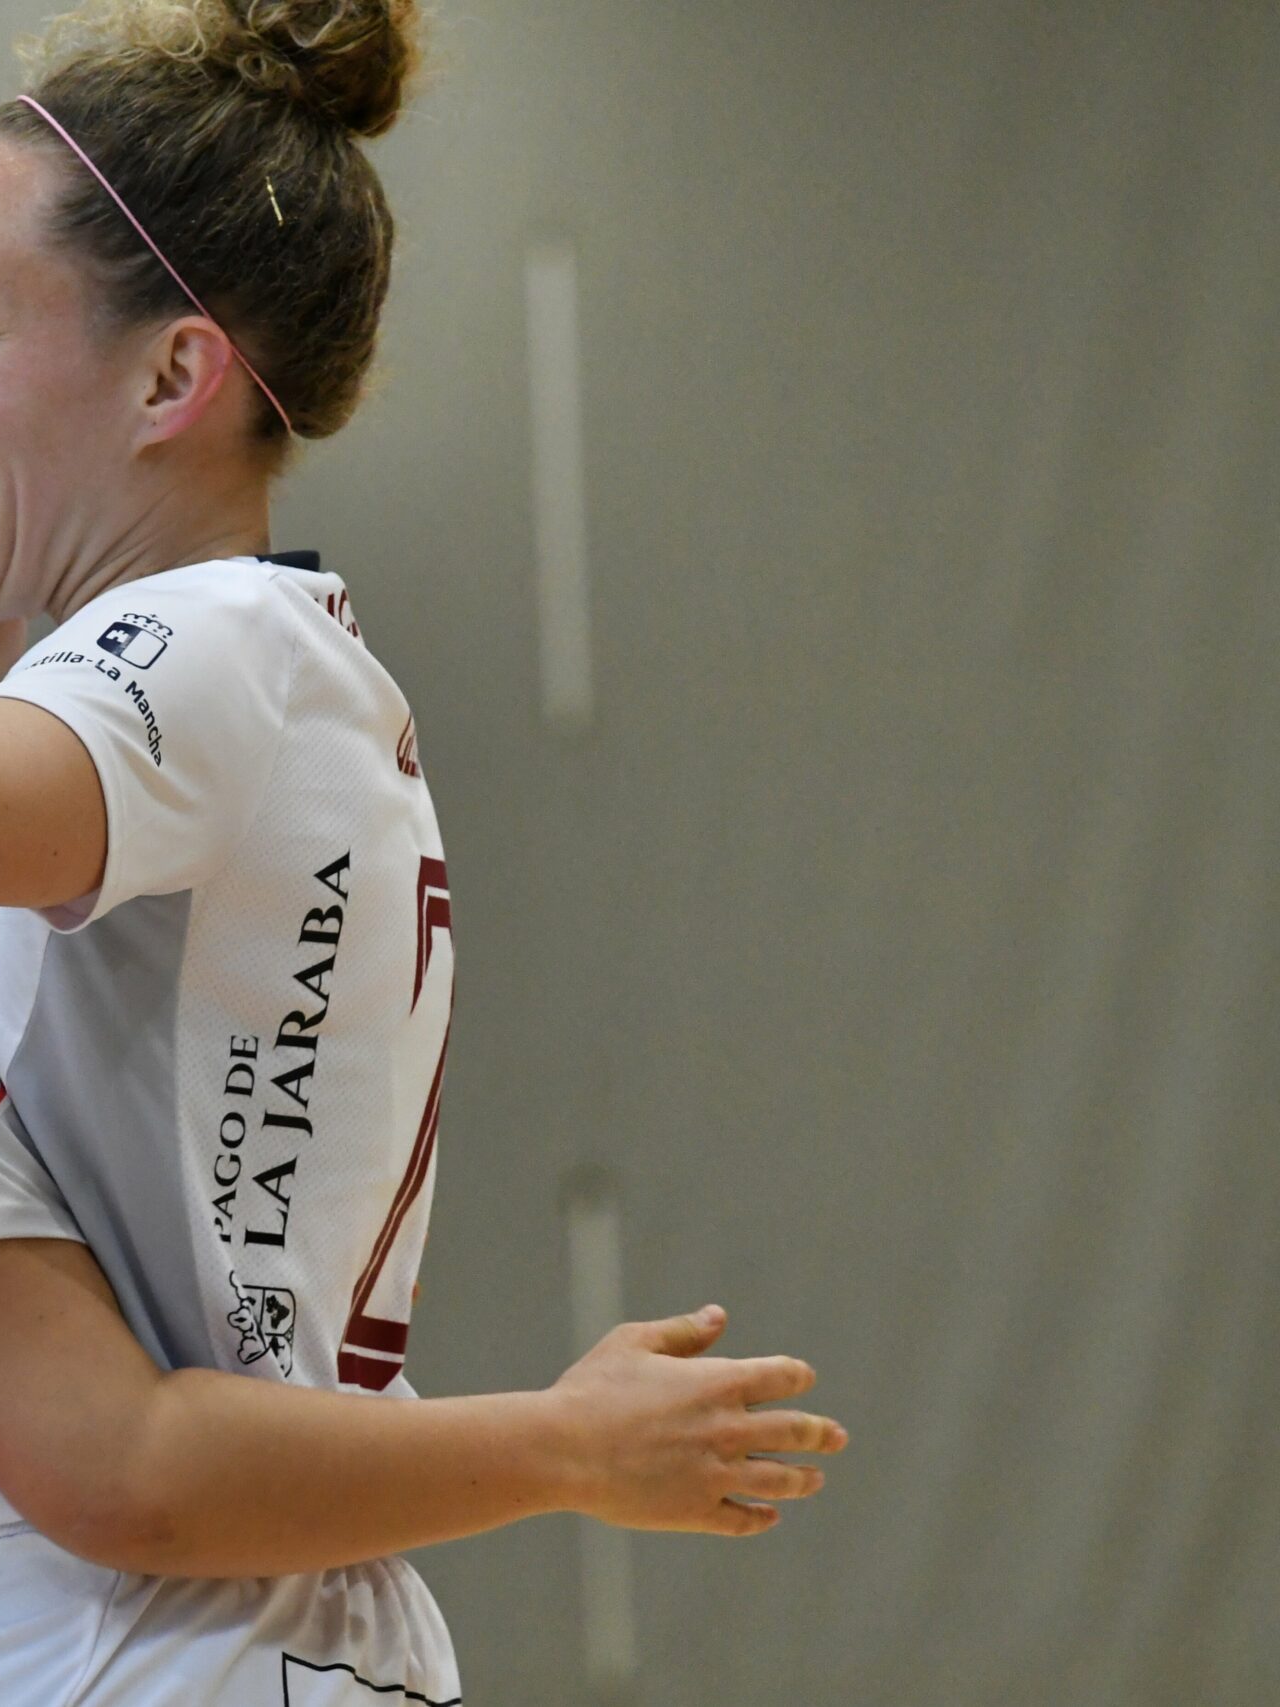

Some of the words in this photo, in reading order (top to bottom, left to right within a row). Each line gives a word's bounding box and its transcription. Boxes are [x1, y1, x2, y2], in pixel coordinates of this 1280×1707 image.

[124, 680, 163, 767] Mancha
[261, 847, 352, 1139] JARABA
[224, 1034, 260, 1098] DE
[244, 1155, 298, 1251] LA
